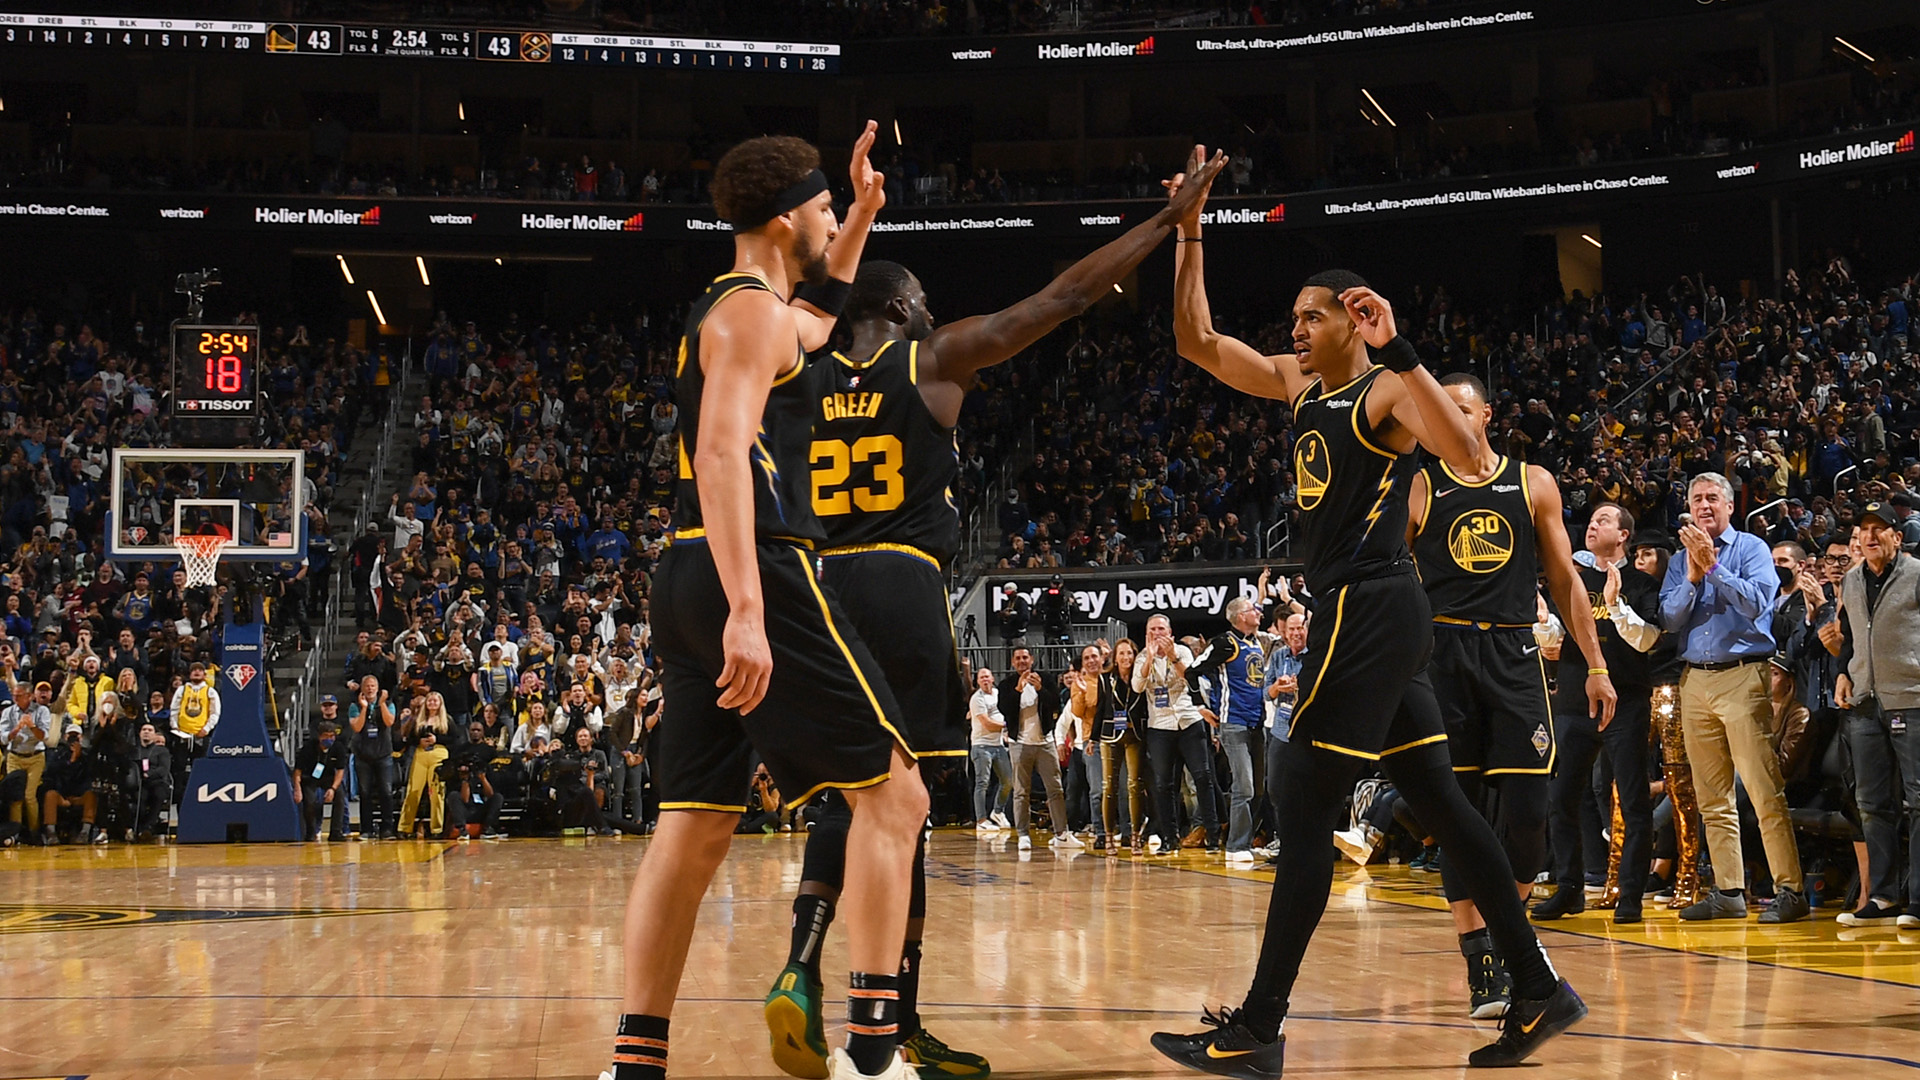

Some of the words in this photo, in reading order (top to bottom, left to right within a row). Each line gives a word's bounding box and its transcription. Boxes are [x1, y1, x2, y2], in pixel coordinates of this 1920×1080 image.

[81, 18, 97, 26] STL
[1196, 39, 1248, 50] Ultra-fast,
[1249, 33, 1321, 49] ultra-powerful
[1322, 32, 1337, 42] 5G
[1338, 30, 1363, 41] Ultra
[1363, 22, 1416, 38] Wideband
[1416, 22, 1425, 31] is
[1426, 20, 1449, 30] here
[1450, 17, 1460, 28] in
[1461, 15, 1495, 27] Chase
[1495, 11, 1534, 22] Center.
[6, 29, 15, 41] 3
[43, 30, 56, 42] 14
[84, 32, 93, 44] 2
[123, 33, 131, 45] 4
[161, 34, 170, 46] 5
[200, 35, 208, 47] 7
[234, 36, 249, 49] 20
[307, 30, 331, 49] 43
[349, 30, 368, 38] TOL
[371, 29, 379, 40] 6
[392, 29, 427, 48] 2:54
[441, 33, 459, 42] TOL
[463, 32, 470, 43] 5
[349, 44, 367, 52] FLS
[371, 43, 378, 54] 4
[441, 47, 458, 55] FLS
[462, 46, 469, 57] 4
[487, 36, 511, 56] 43
[630, 38, 654, 46] DREB
[705, 41, 722, 49] BLK
[775, 44, 793, 52] POT
[1038, 43, 1083, 60] Holier
[1086, 42, 1136, 58] Molier
[562, 49, 575, 61] 12
[601, 50, 609, 62] 4
[635, 51, 647, 63] 13
[672, 53, 681, 65] 3
[709, 54, 715, 66] 1
[744, 55, 752, 68] 3
[779, 57, 788, 69] 6
[811, 58, 826, 70] 26
[952, 48, 991, 60] verizon
[1800, 150, 1844, 169] Holier
[1846, 140, 1897, 161] Molier
[1716, 165, 1755, 179] verizon
[1325, 201, 1375, 215] Ultra-fast,
[1375, 193, 1448, 209] ultra-powerful
[1448, 191, 1465, 203] 5G
[1465, 190, 1492, 201] Ultra
[1492, 184, 1546, 199] Wideband
[1546, 183, 1556, 194] is
[1556, 182, 1582, 193] here
[1582, 180, 1593, 191] in
[1593, 178, 1628, 190] Chase
[1629, 174, 1669, 187] Center.
[0, 205, 15, 214] ere
[16, 203, 27, 214] in
[28, 204, 66, 215] Chase
[67, 204, 110, 216] Center.
[160, 207, 203, 219] verizon
[255, 207, 305, 223] Holier
[307, 208, 361, 224] Molier
[1216, 208, 1267, 224] Molier
[429, 213, 472, 225] verizon
[521, 213, 571, 229] Holier
[572, 214, 624, 231] Molier
[686, 219, 734, 231] Ultra-fas
[915, 220, 924, 231] is
[925, 219, 949, 230] here
[950, 219, 960, 229] in
[960, 218, 995, 229] Chase
[995, 217, 1034, 228] Center.
[1080, 215, 1120, 225] verizon
[198, 332, 248, 354] 2:54
[205, 355, 242, 393] 18
[198, 400, 253, 410] TISSOT
[822, 392, 884, 422] GREEN
[1306, 440, 1317, 463] 3
[809, 434, 905, 517] 23
[1492, 484, 1520, 493] Rakuten
[1471, 515, 1500, 535] 30
[993, 586, 1108, 619] btay
[1118, 583, 1228, 615] betway
[213, 745, 242, 756] Google
[244, 745, 263, 754] Pixel
[197, 782, 277, 802] KIA
